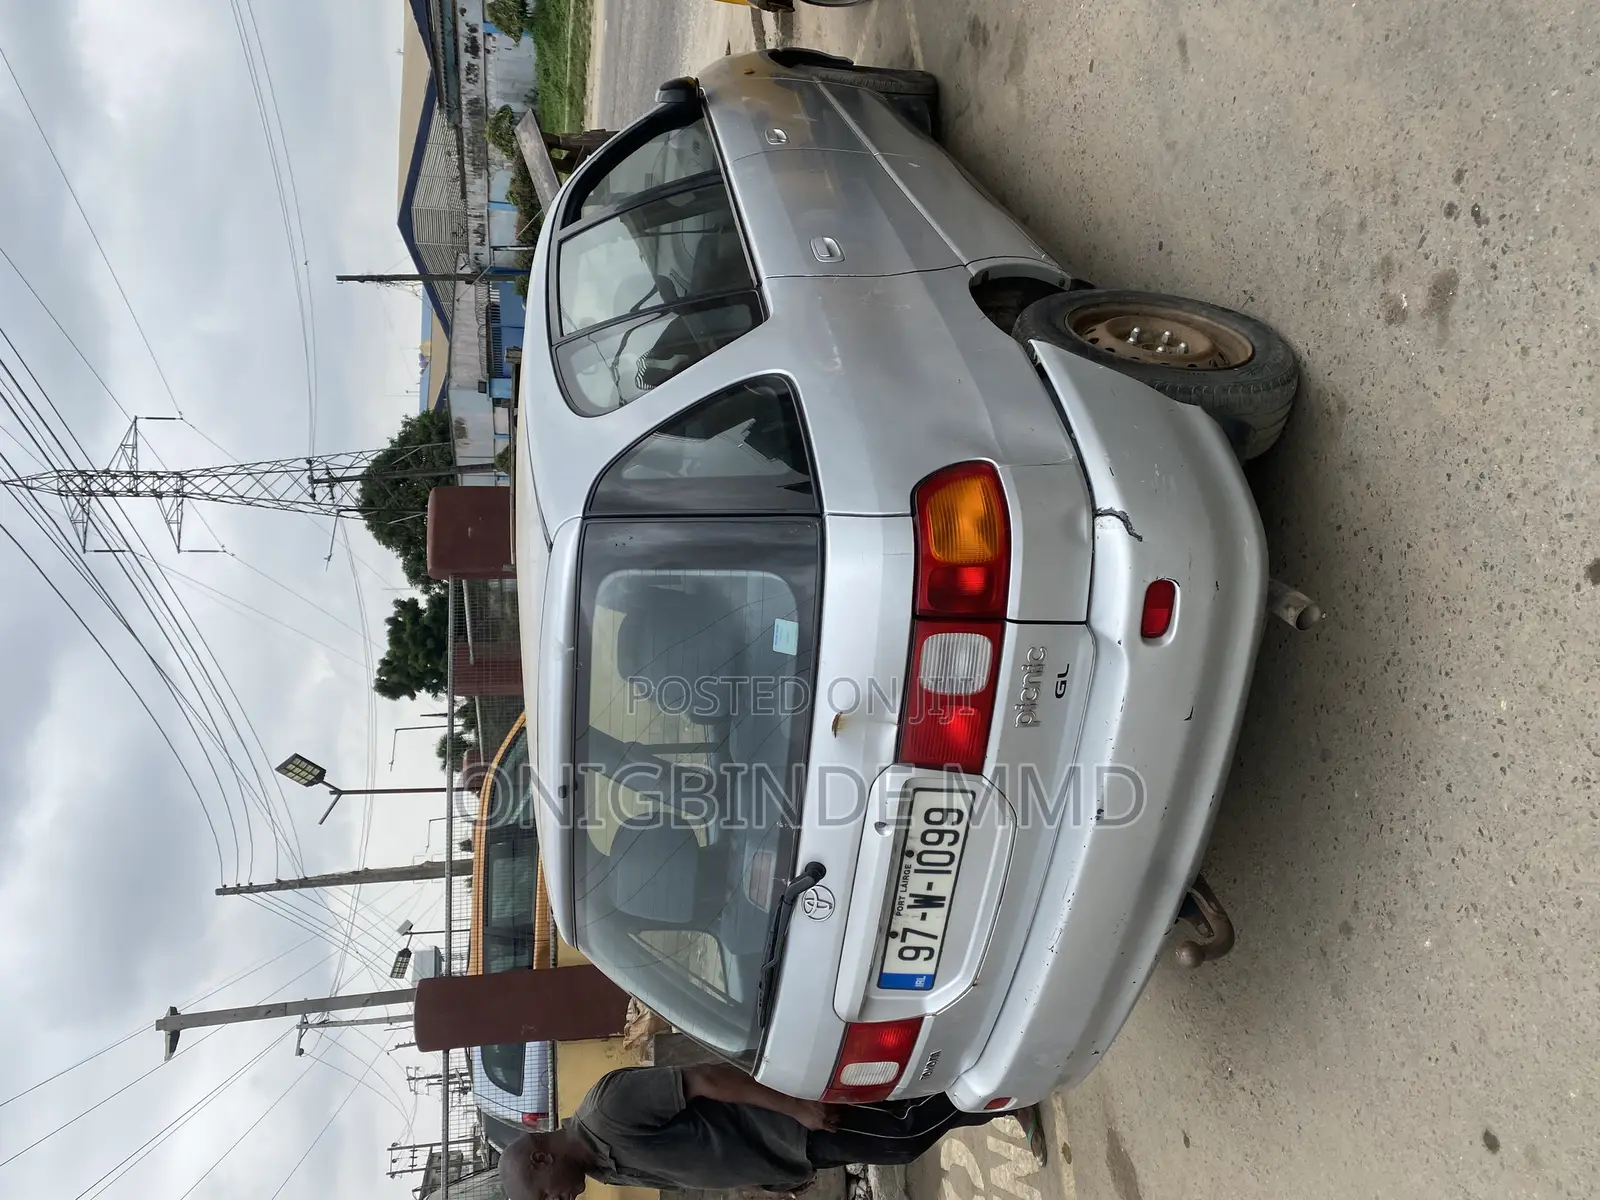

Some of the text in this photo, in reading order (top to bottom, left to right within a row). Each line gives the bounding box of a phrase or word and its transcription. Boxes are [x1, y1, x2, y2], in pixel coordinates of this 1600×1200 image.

[1014, 647, 1047, 728] picnic
[1055, 664, 1069, 699] GL
[898, 807, 964, 962] 97-W-1099
[895, 895, 906, 917] PORT
[915, 975, 926, 988] IRL
[919, 1048, 942, 1081] TOYOTA
